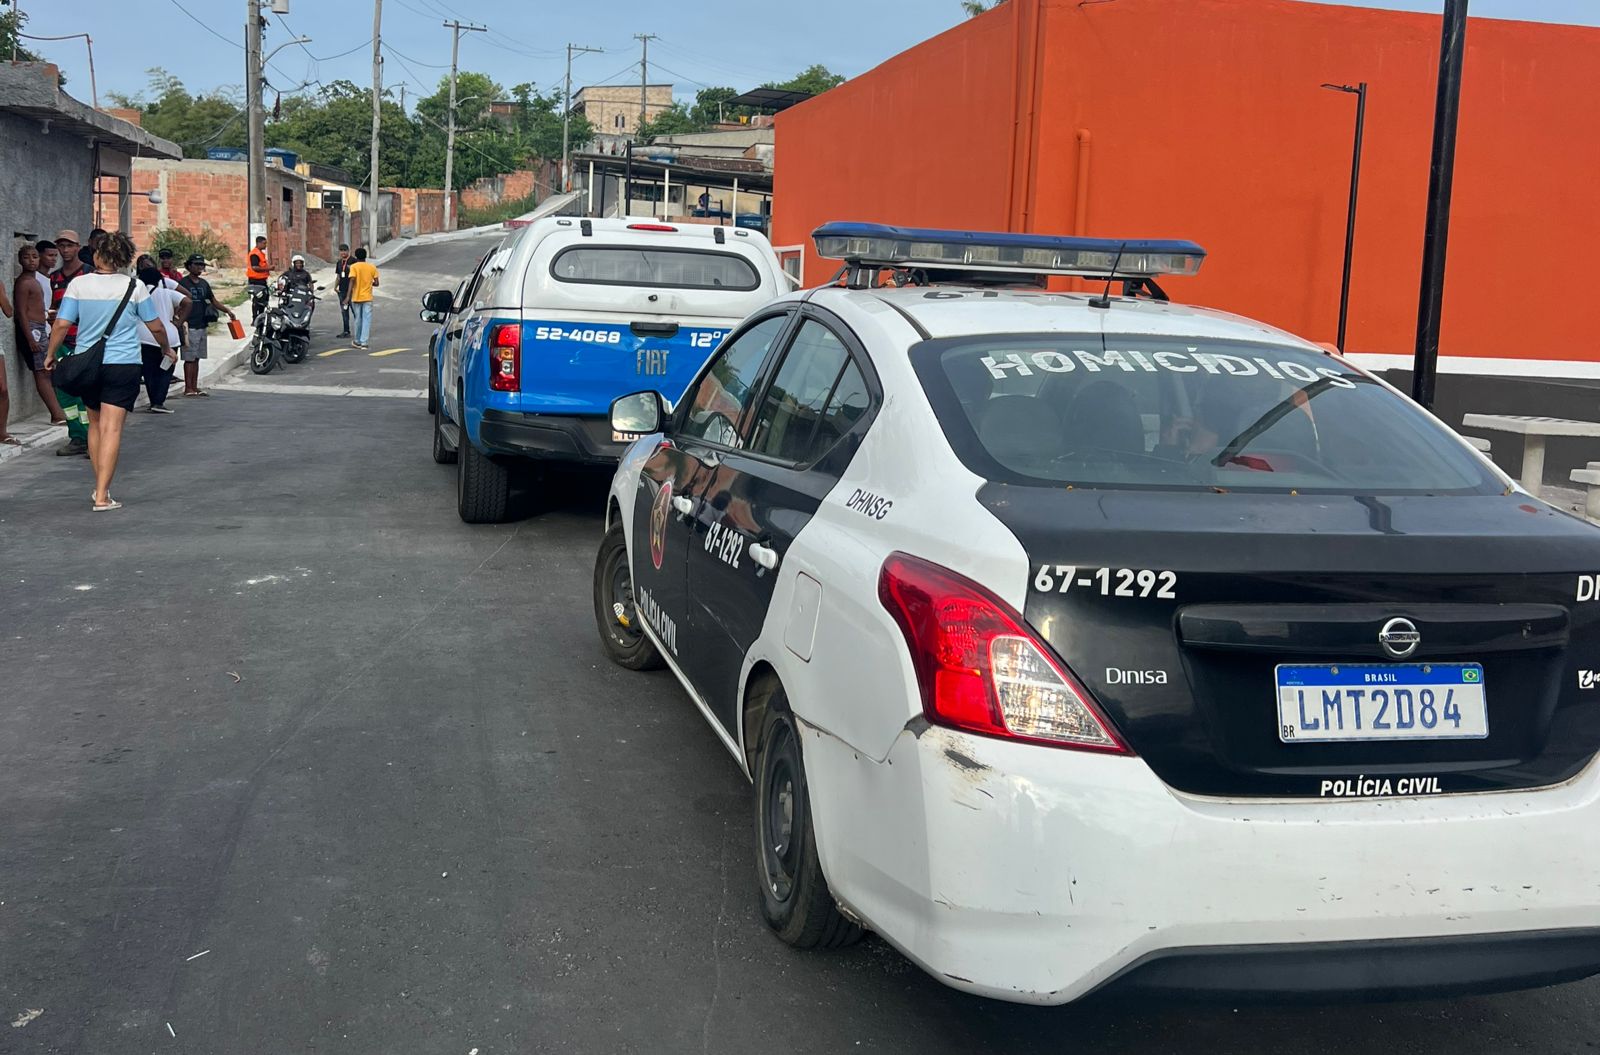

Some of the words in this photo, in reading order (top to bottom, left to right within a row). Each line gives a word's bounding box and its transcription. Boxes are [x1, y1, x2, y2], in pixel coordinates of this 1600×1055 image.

[535, 327, 621, 344] 52-4068
[636, 350, 670, 376] FIAT
[980, 346, 1357, 390] HOMICÍDIOS
[846, 488, 893, 520] DHNSG
[704, 521, 744, 569] 67-1292
[1034, 564, 1177, 599] 67-1292
[639, 586, 661, 635] POLÍCIA
[660, 610, 678, 657] CIVIL
[1364, 673, 1398, 683] BRASIL
[1297, 688, 1462, 730] LMT2D84
[1283, 725, 1295, 738] BR
[1320, 774, 1393, 797] POLÍCIA
[1397, 777, 1442, 795] CIVIL
